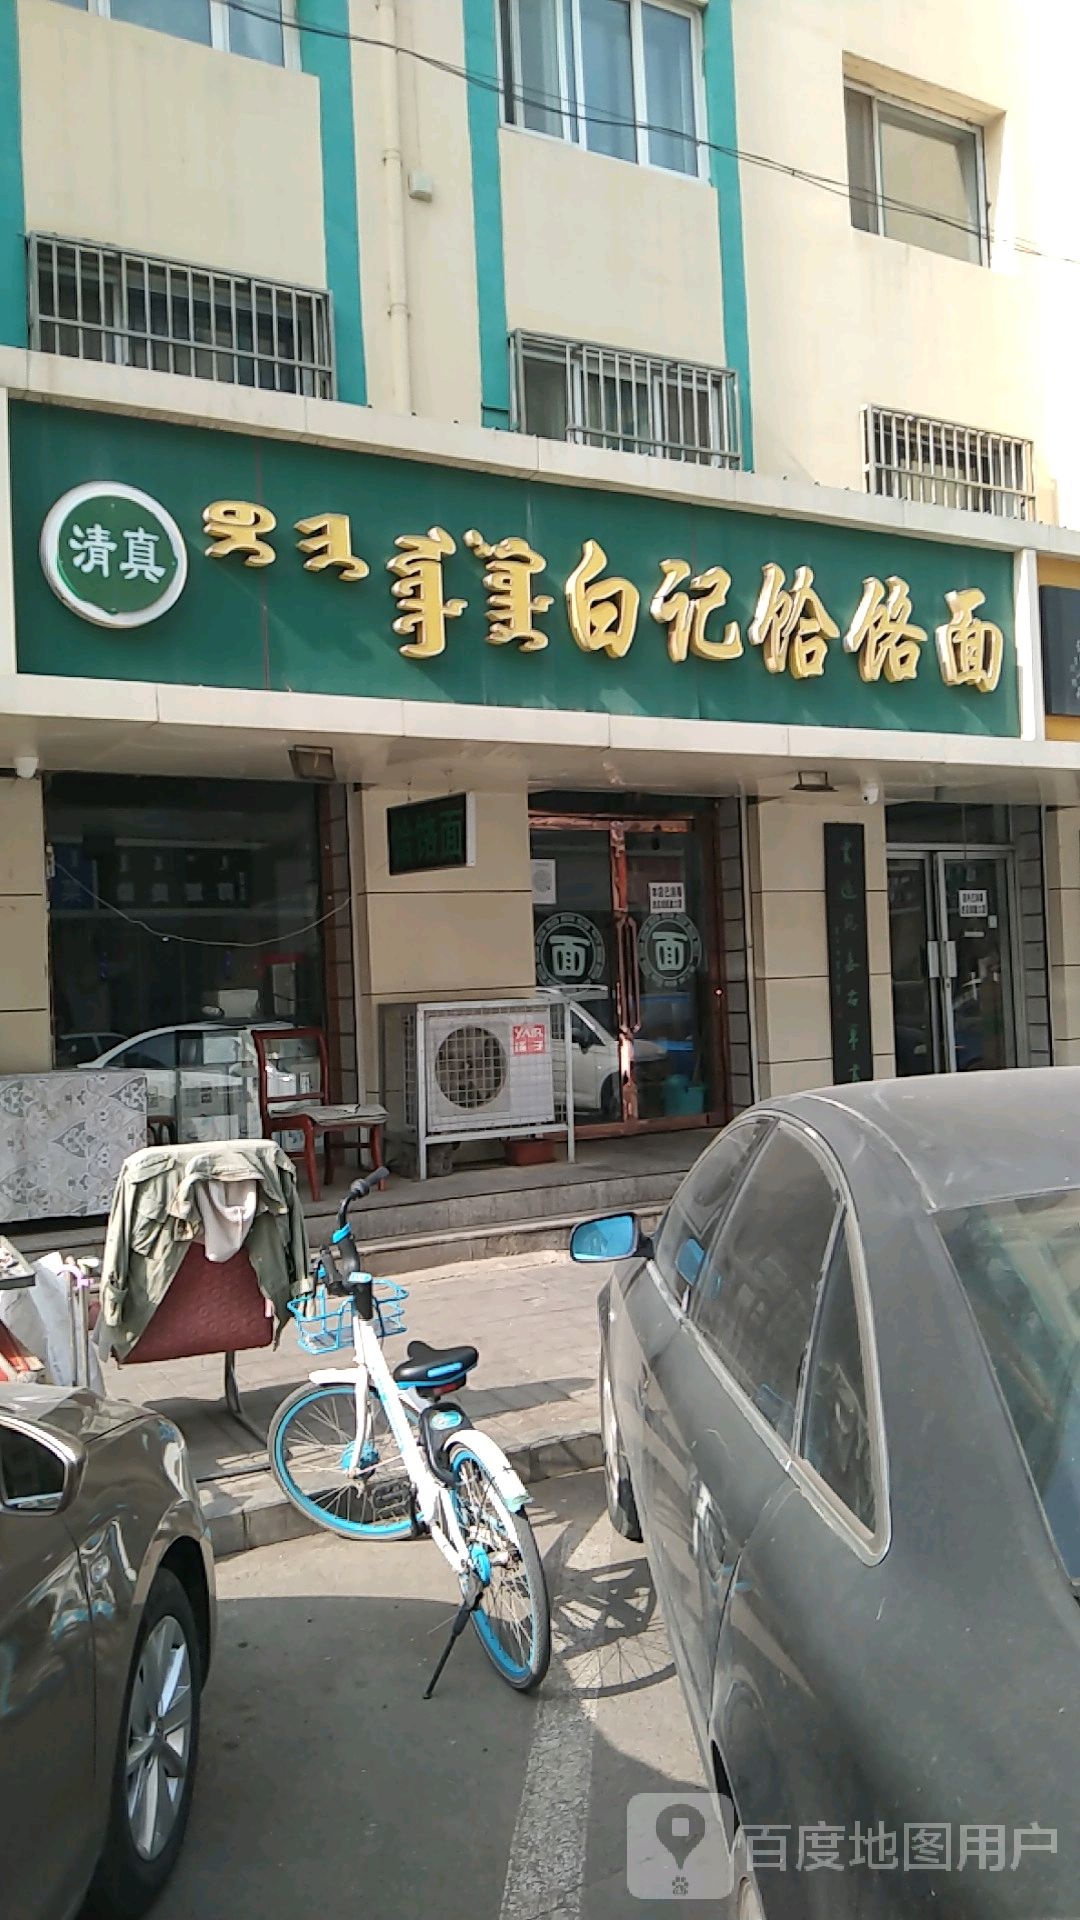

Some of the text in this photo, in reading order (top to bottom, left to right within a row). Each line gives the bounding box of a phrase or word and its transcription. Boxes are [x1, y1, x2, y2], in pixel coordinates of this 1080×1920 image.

[70, 523, 165, 584] 清真
[565, 539, 1004, 693] 白记饸饹面
[549, 935, 591, 976] 面
[652, 931, 688, 971] 面
